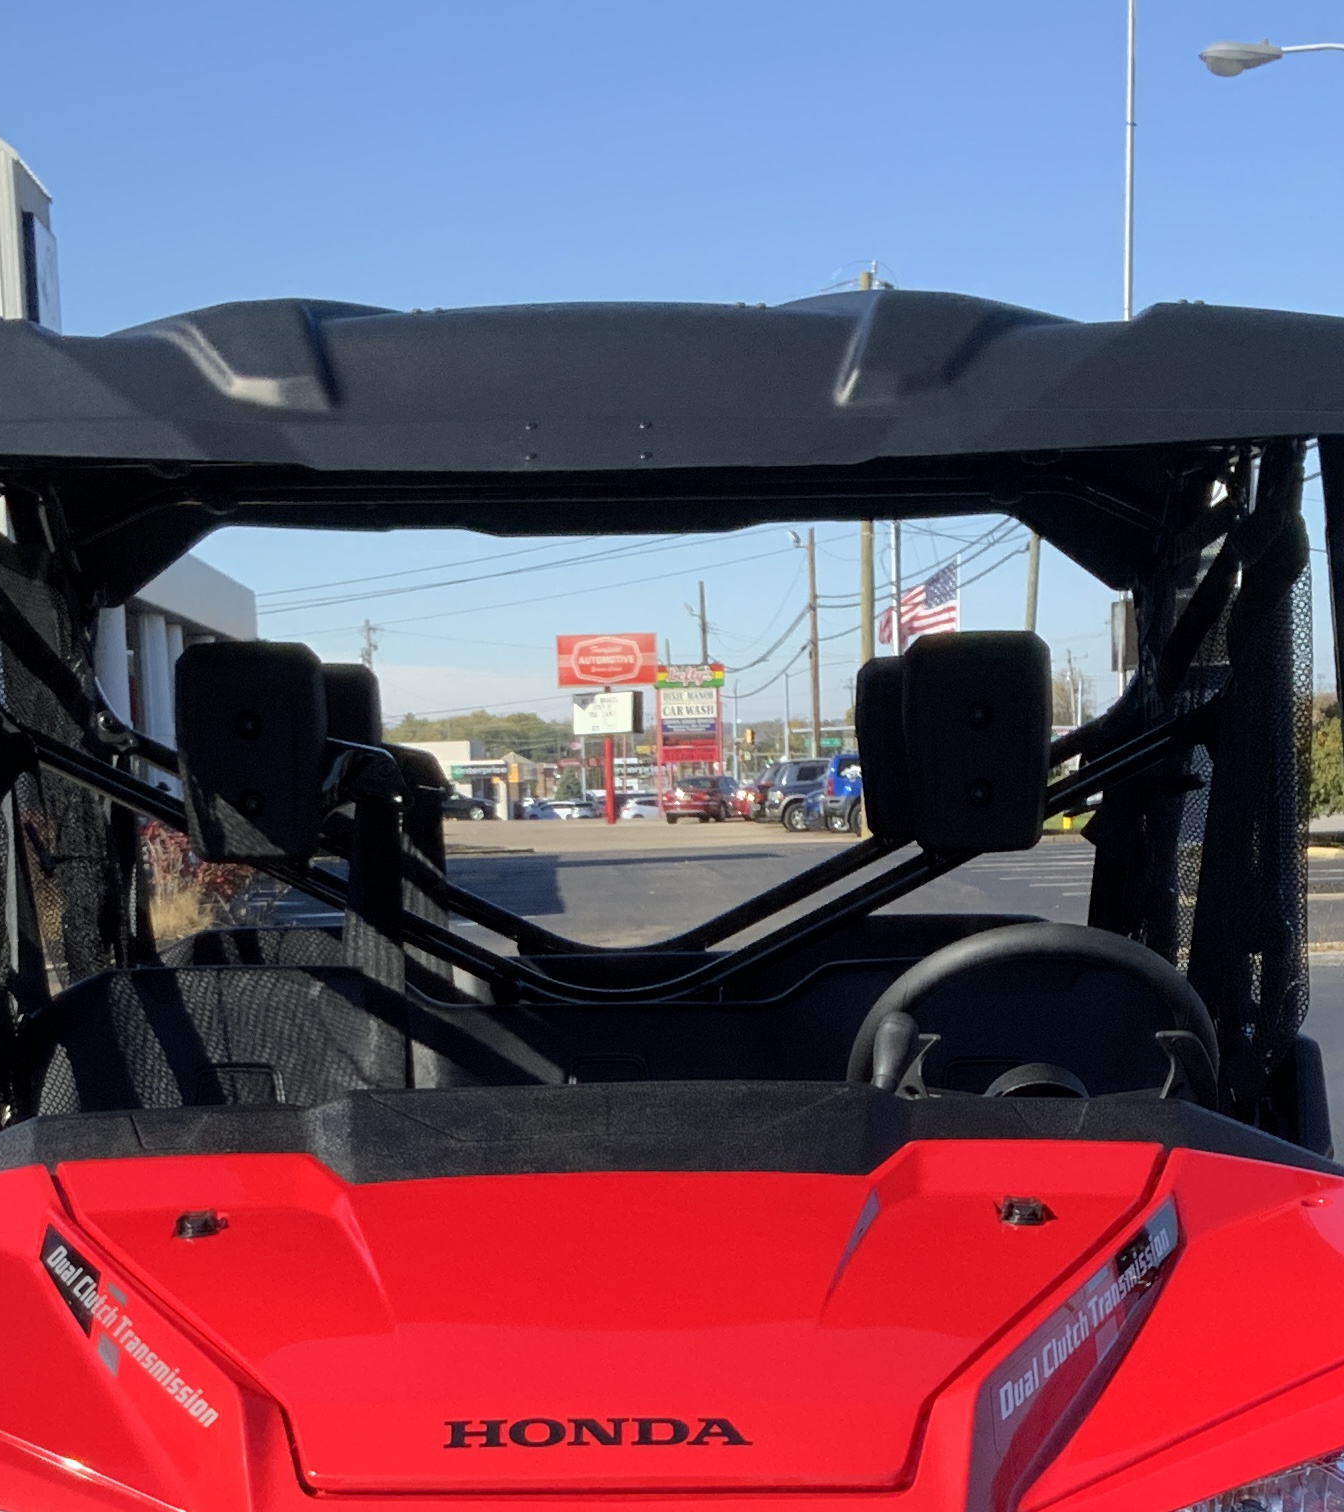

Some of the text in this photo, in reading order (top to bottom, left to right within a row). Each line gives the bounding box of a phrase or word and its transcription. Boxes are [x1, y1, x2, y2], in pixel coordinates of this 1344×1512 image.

[578, 654, 635, 665] AUTOMOTIVE
[663, 705, 714, 716] CAR WASH
[46, 1245, 219, 1428] Dual Clutch Transmission
[999, 1227, 1170, 1420] Dual Clutch Transmission
[443, 1417, 753, 1448] HONDA
